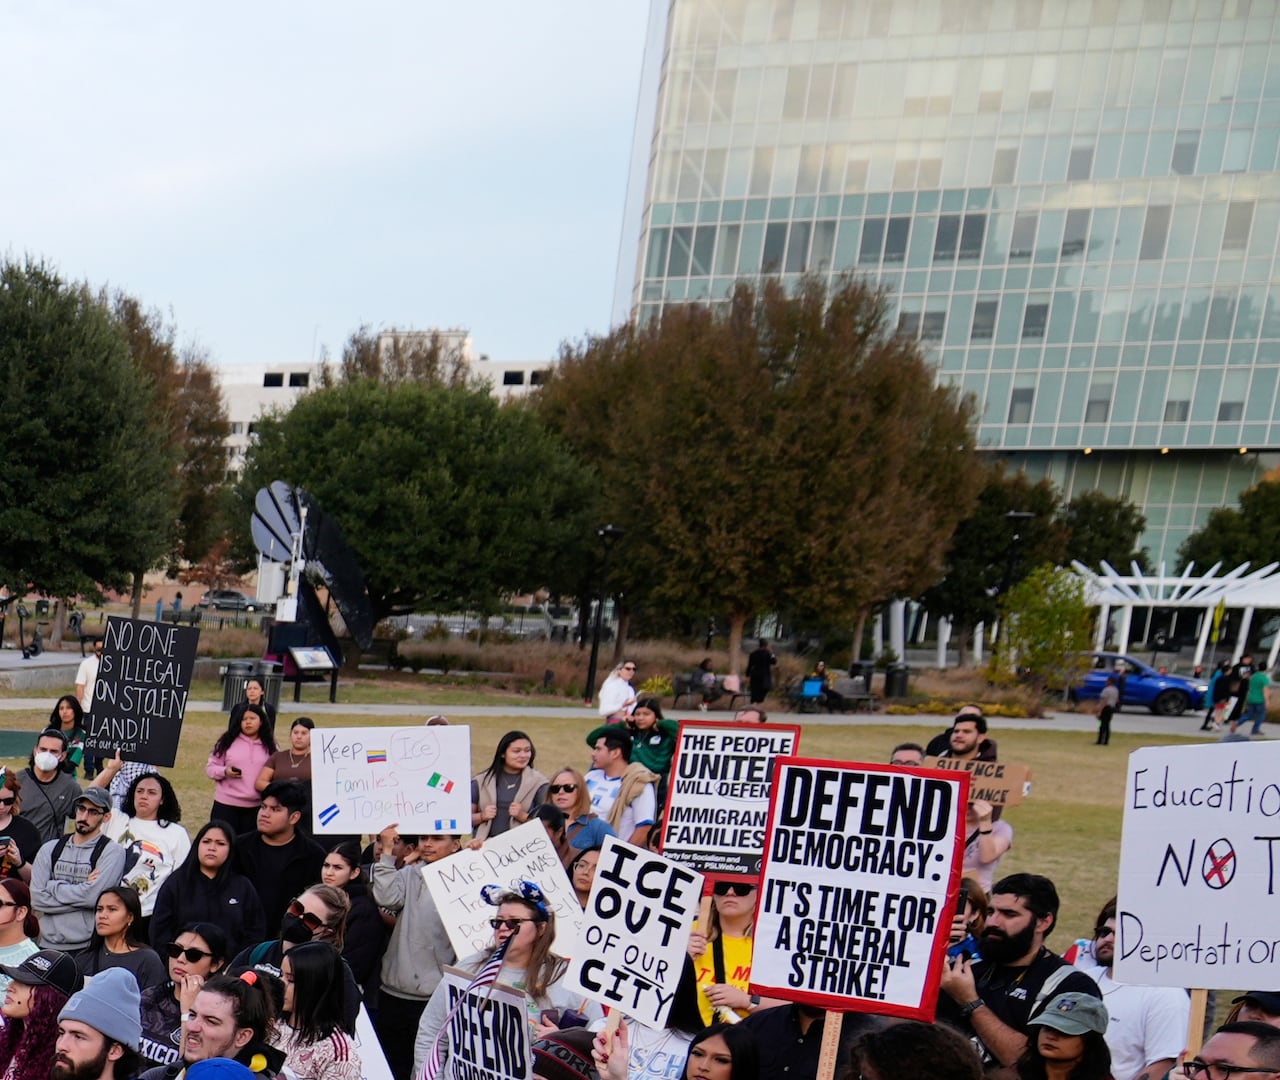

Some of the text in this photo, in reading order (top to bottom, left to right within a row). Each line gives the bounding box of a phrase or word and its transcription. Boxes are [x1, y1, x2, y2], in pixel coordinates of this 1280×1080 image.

[104, 621, 178, 658] NO ONE
[99, 654, 183, 687] IS ILLEGAL
[96, 679, 187, 719] ON STOLEN
[321, 733, 433, 765] Keep Ice
[682, 735, 791, 754] THE PEOPLE
[347, 791, 438, 822] Together
[676, 780, 772, 798] WILL DEFEN
[779, 766, 953, 842] DEFEND
[1133, 759, 1280, 817] Educatio
[668, 806, 769, 828] IMMIGRAN
[438, 837, 548, 894] Mis Padres
[599, 843, 695, 916] ICE
[771, 828, 945, 882] DEMOCRACY:
[594, 886, 682, 947] OUT
[764, 878, 937, 934] IT'S TIME FOR
[585, 925, 621, 954] OF
[623, 944, 669, 983] OUR
[775, 916, 911, 968] A GENERAL
[579, 958, 675, 1023] CITY
[788, 951, 890, 1000] STRIKE!
[448, 983, 528, 1080] DEFEND
